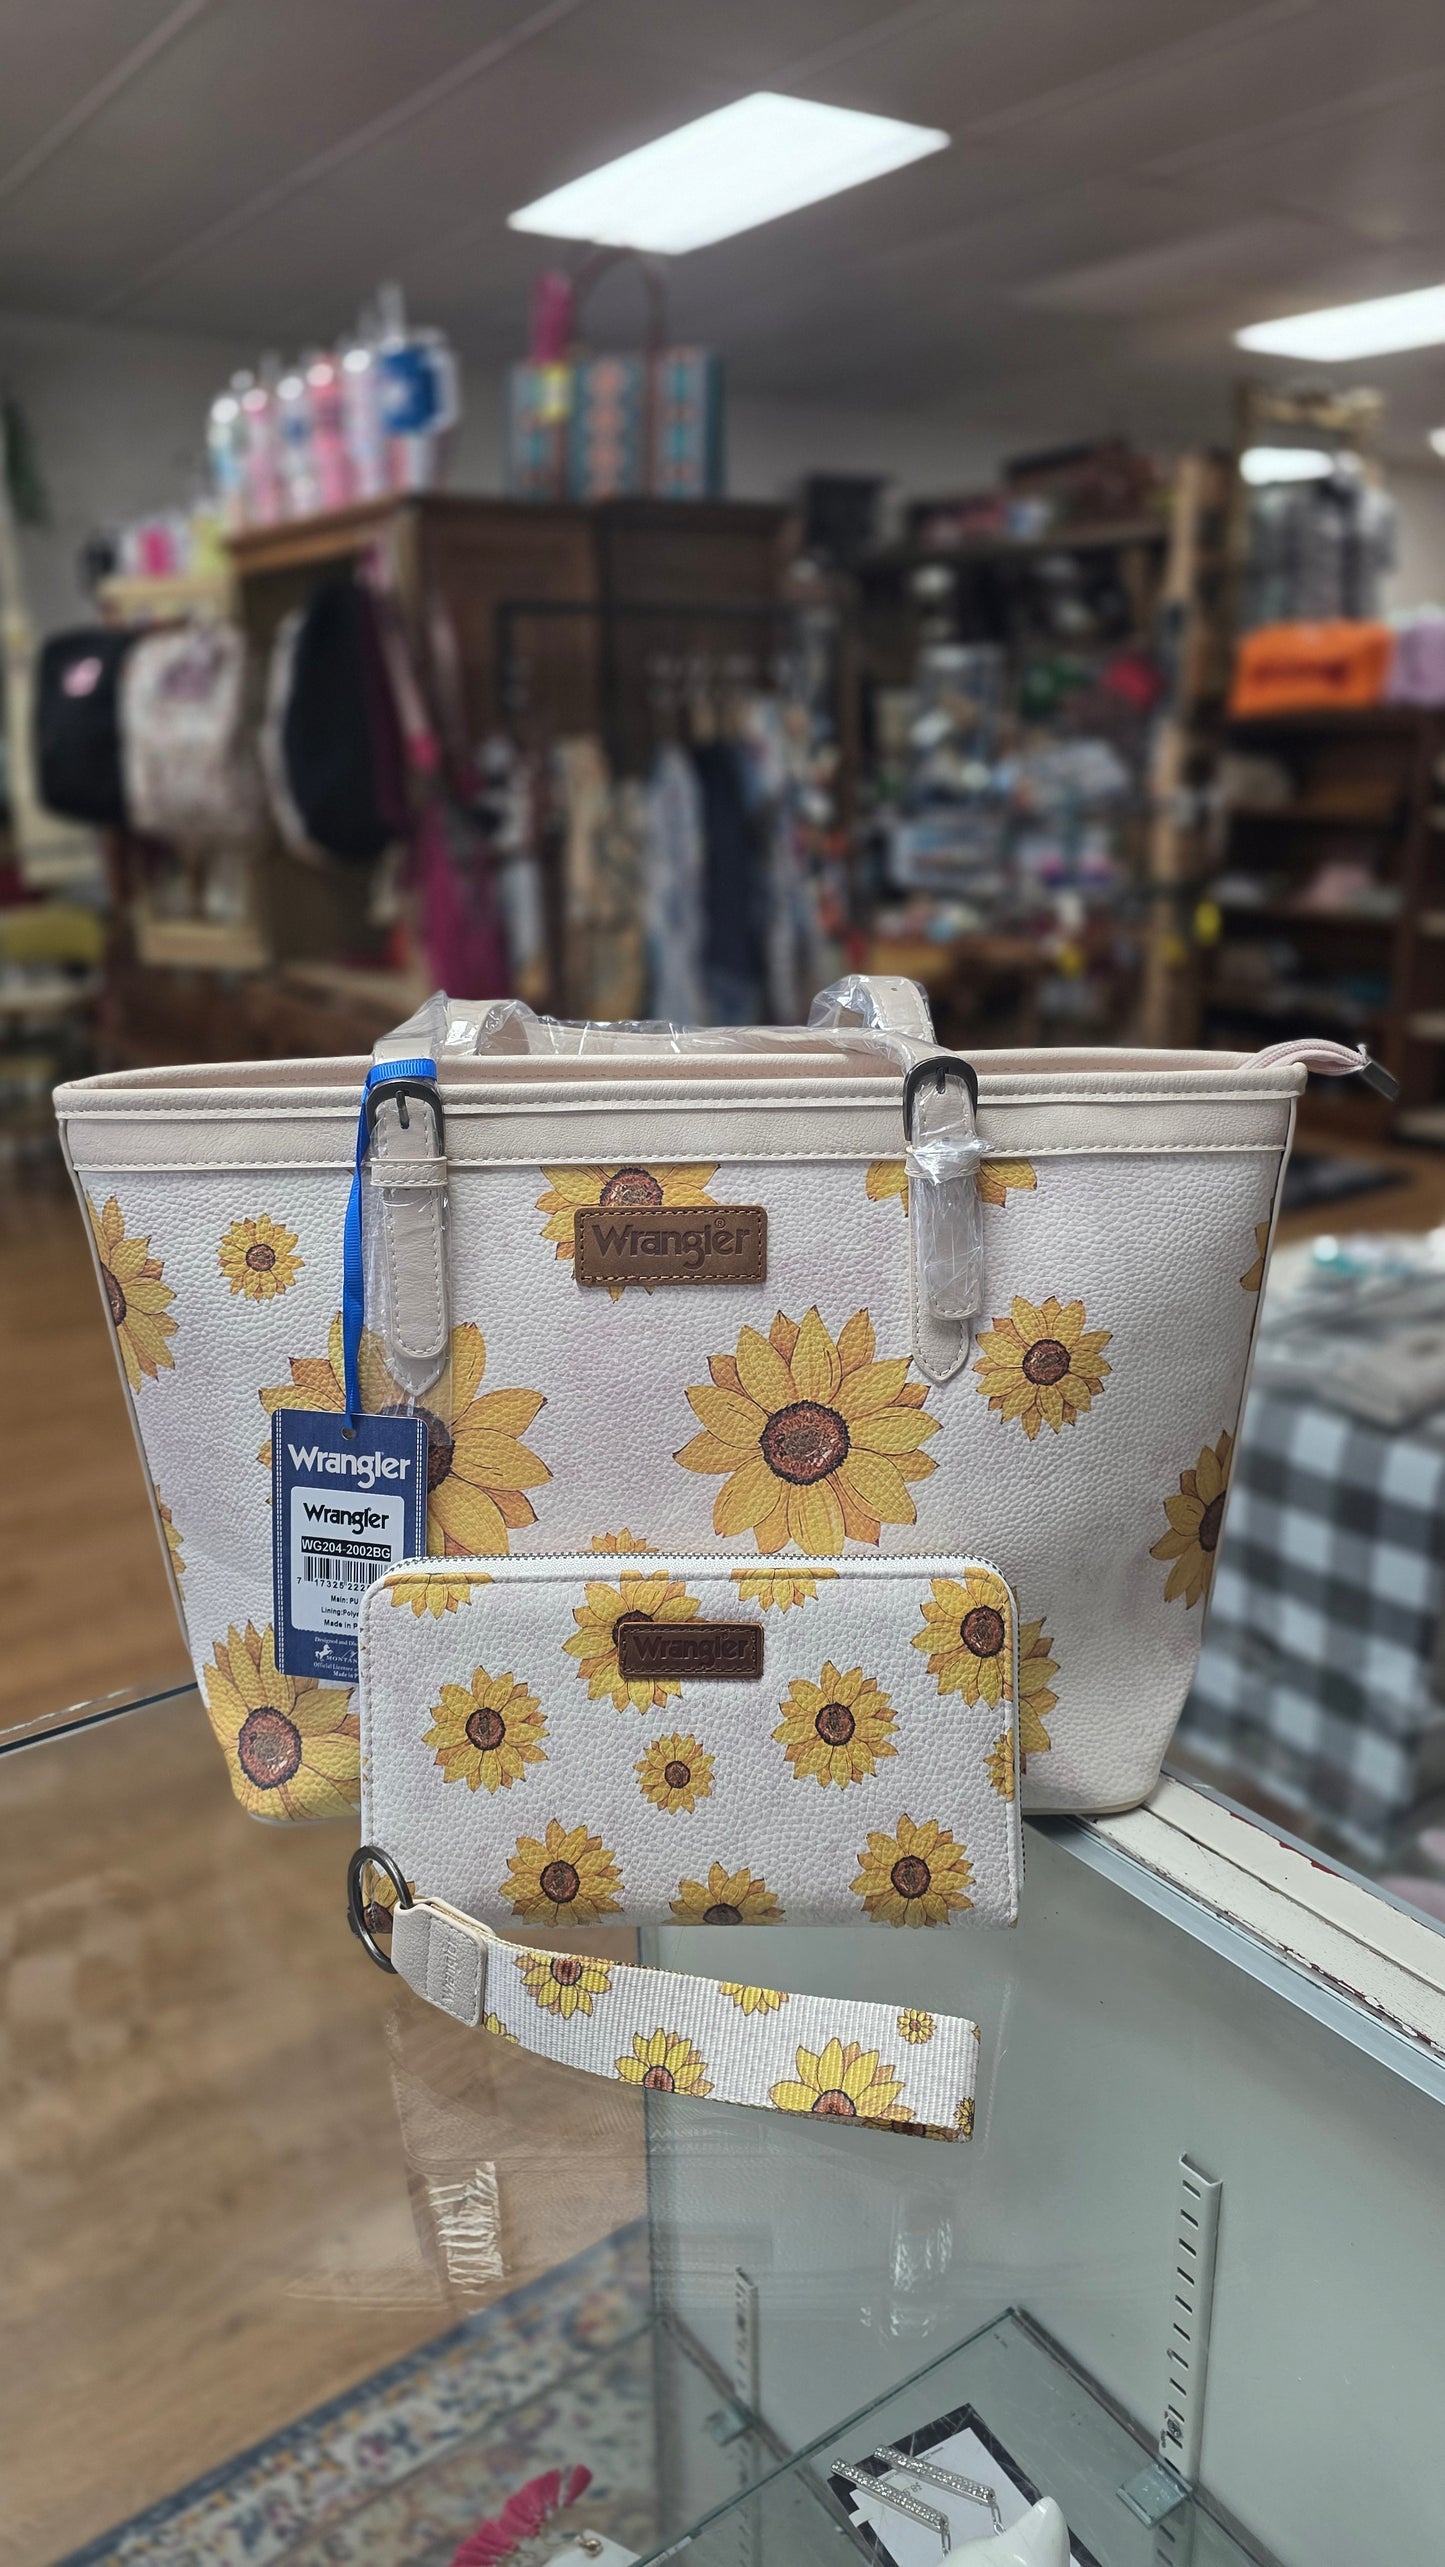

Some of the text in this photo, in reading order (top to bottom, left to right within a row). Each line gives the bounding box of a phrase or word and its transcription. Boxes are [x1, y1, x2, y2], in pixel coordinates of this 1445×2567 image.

[592, 1224, 751, 1270] Wrangler
[287, 1443, 411, 1489] Wrangler
[303, 1502, 389, 1535] Wrangler
[301, 1538, 391, 1559] WG204-2002BG
[330, 1595, 359, 1605] Main: PU
[324, 1618, 342, 1628] Made
[344, 1621, 351, 1629] in
[326, 1655, 358, 1664] MONTAN
[633, 1635, 750, 1670] Wrangler
